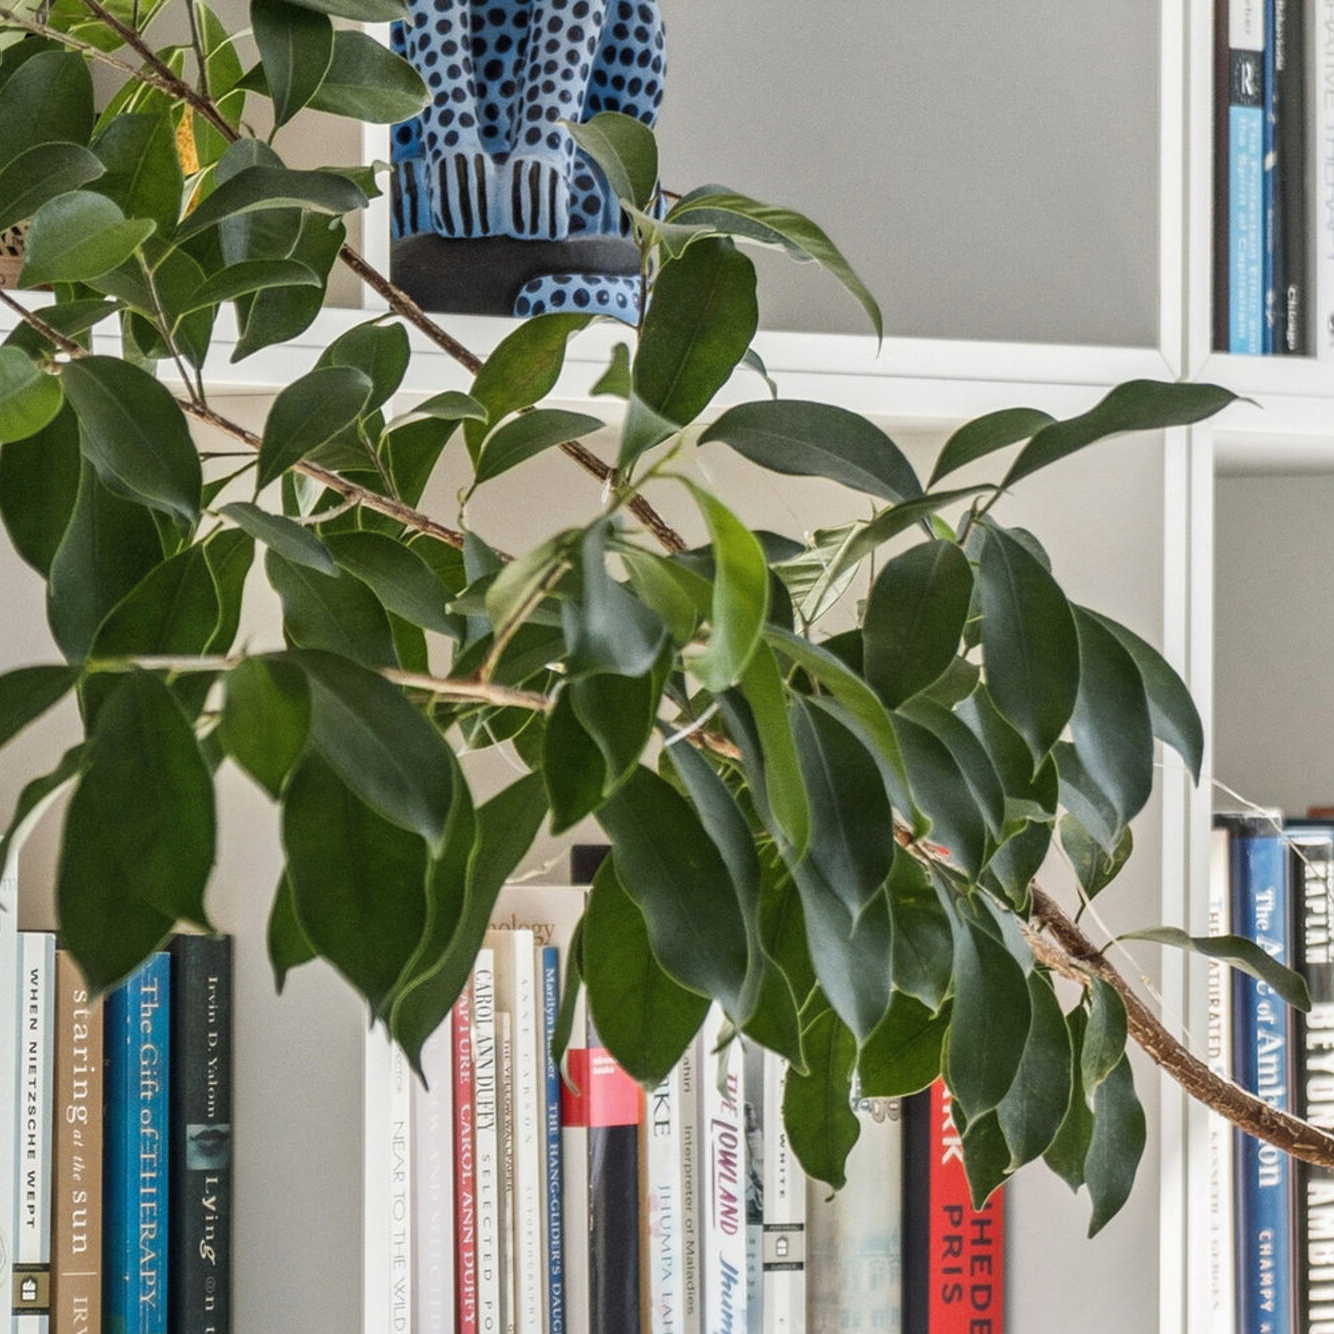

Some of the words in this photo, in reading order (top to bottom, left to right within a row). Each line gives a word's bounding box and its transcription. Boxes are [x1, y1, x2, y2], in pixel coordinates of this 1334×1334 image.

[1286, 284, 1298, 351] Chicago
[1254, 888, 1279, 931] The
[27, 968, 40, 1031] WHEN
[138, 977, 160, 1035] The
[474, 968, 493, 1026] CAROL
[543, 967, 555, 1024] Marilyn
[1255, 1002, 1277, 1026] of
[64, 989, 97, 1126] staring
[26, 1041, 39, 1161] NIETZSCHE
[476, 1076, 495, 1134] DUFFY
[392, 1120, 405, 1185] NEAR
[459, 1104, 473, 1184] CAROL
[682, 1124, 695, 1216] Interpreter
[25, 1170, 37, 1230] WEPT
[709, 1118, 739, 1237] LOWLAND
[70, 1190, 88, 1255] sun
[138, 1147, 159, 1309] THERAPY
[460, 1192, 474, 1244] ANN
[481, 1153, 493, 1282] SELECTED
[392, 1231, 405, 1271] THE
[940, 1203, 964, 1306] PRIS
[1258, 1229, 1274, 1313] CHAMPY
[393, 1277, 405, 1331] WILD
[462, 1251, 476, 1323] DUFFY
